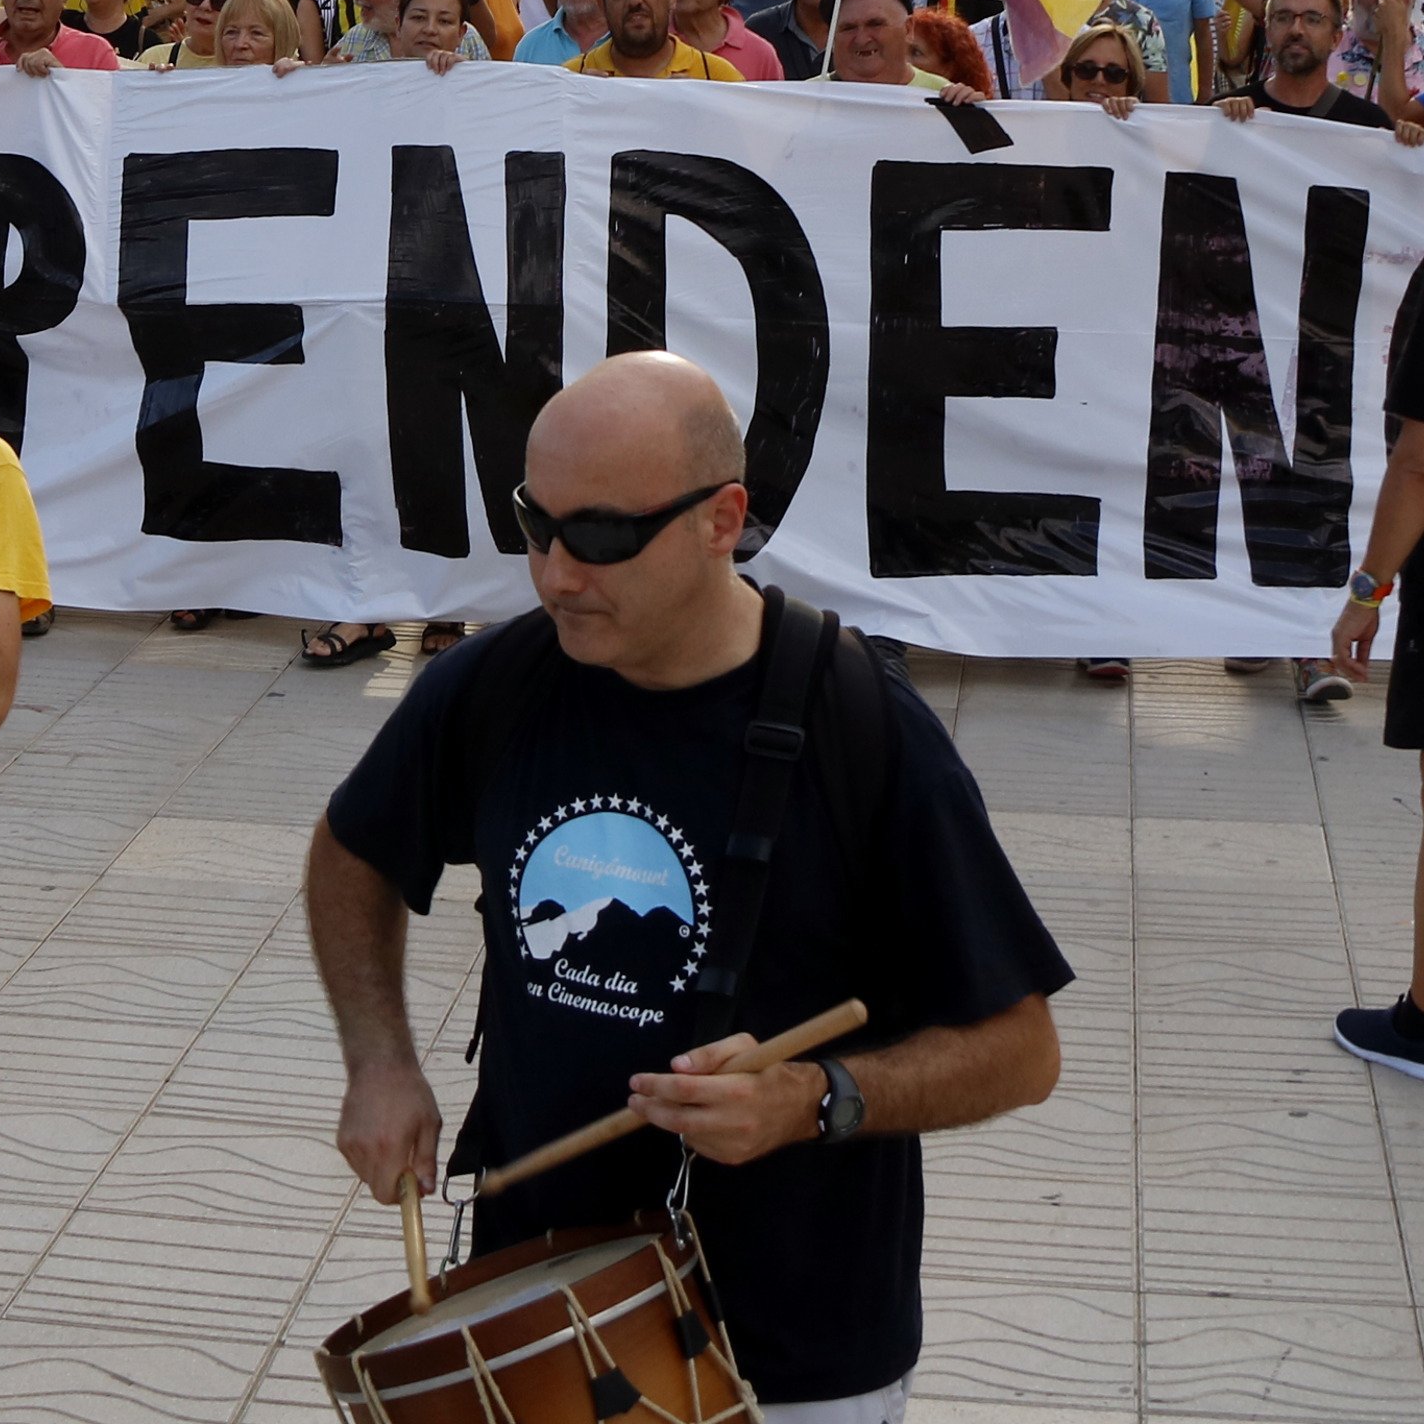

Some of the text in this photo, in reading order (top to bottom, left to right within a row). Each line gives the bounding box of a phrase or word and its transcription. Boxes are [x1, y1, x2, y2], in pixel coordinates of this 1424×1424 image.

[554, 957, 639, 994] Cada dia
[527, 980, 665, 1027] en Cinemascope
